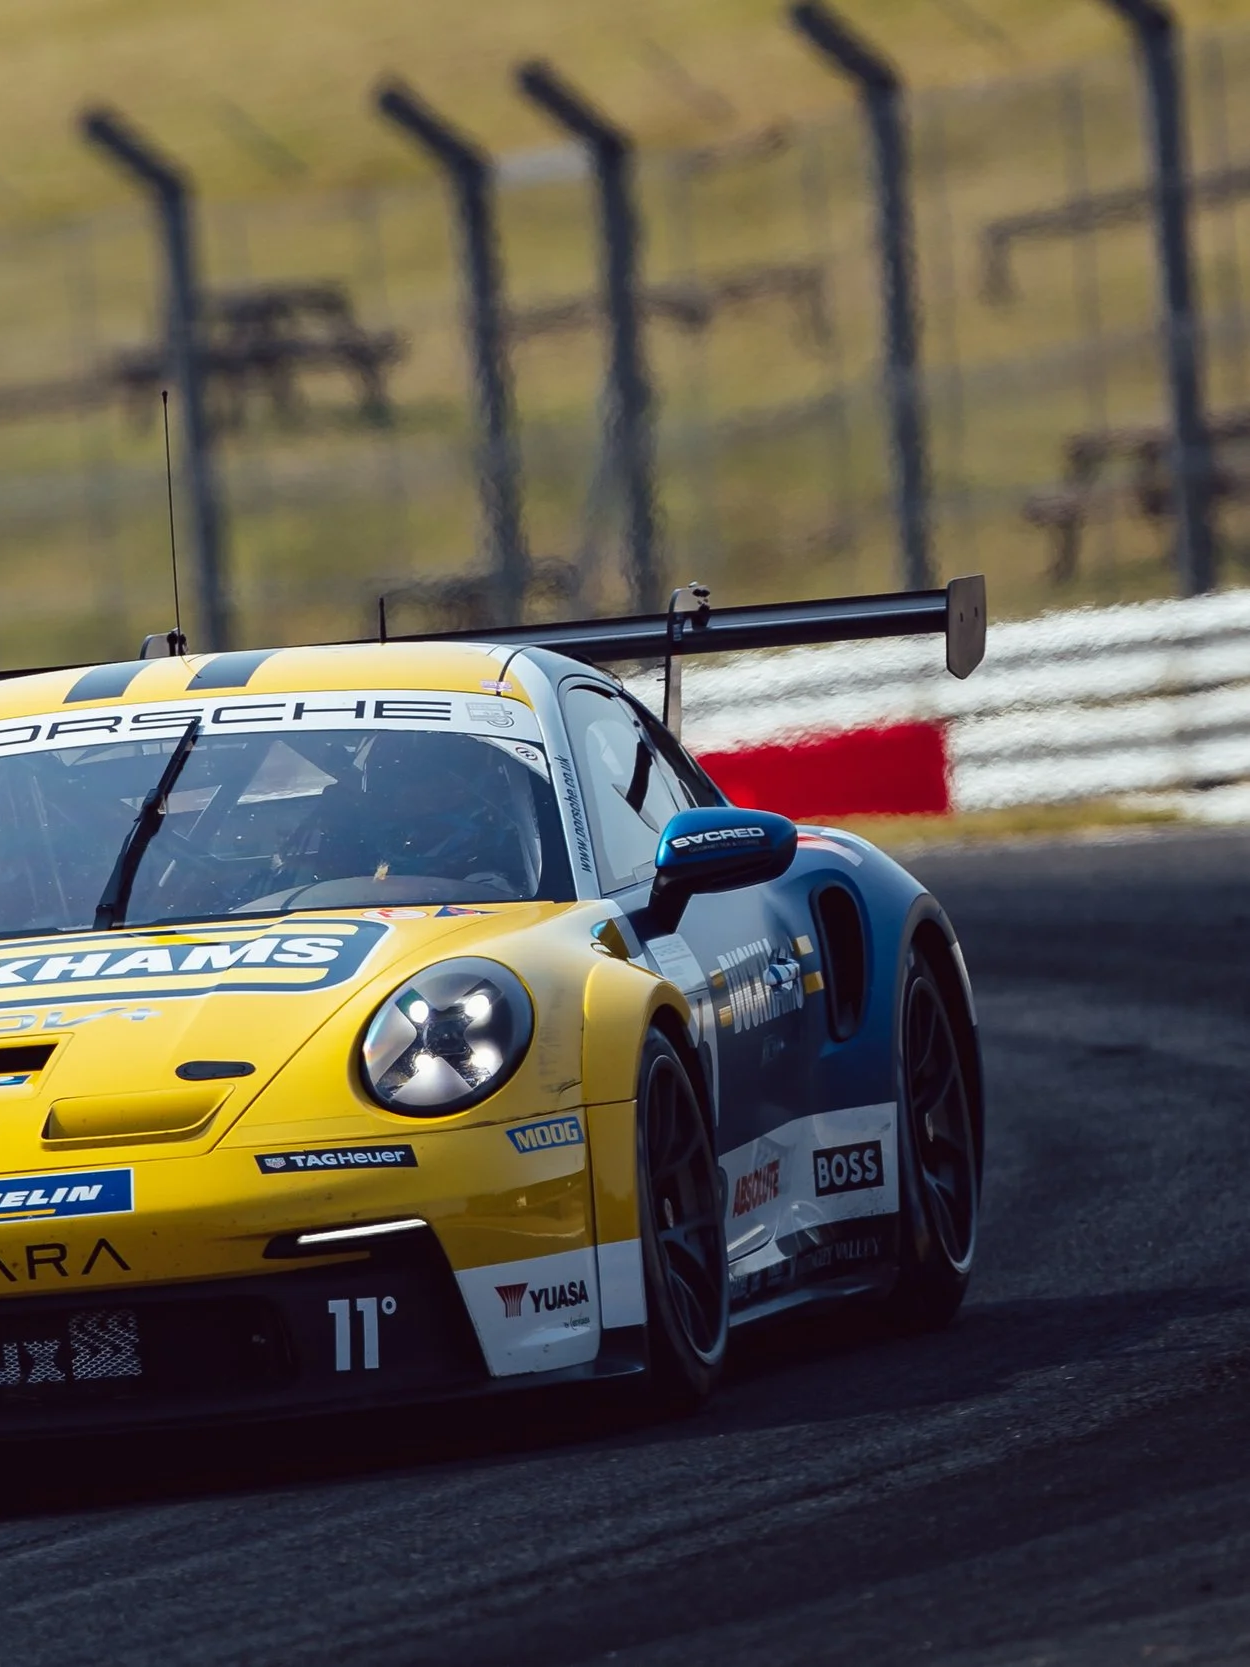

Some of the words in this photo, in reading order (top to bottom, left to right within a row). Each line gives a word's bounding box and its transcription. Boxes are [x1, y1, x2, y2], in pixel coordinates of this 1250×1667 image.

[554, 755, 592, 873] www.porsche.co.uk
[671, 827, 765, 848] SACRED
[514, 1120, 579, 1151] MOOG
[817, 1148, 877, 1189] BOSS
[529, 1279, 589, 1313] YUASA
